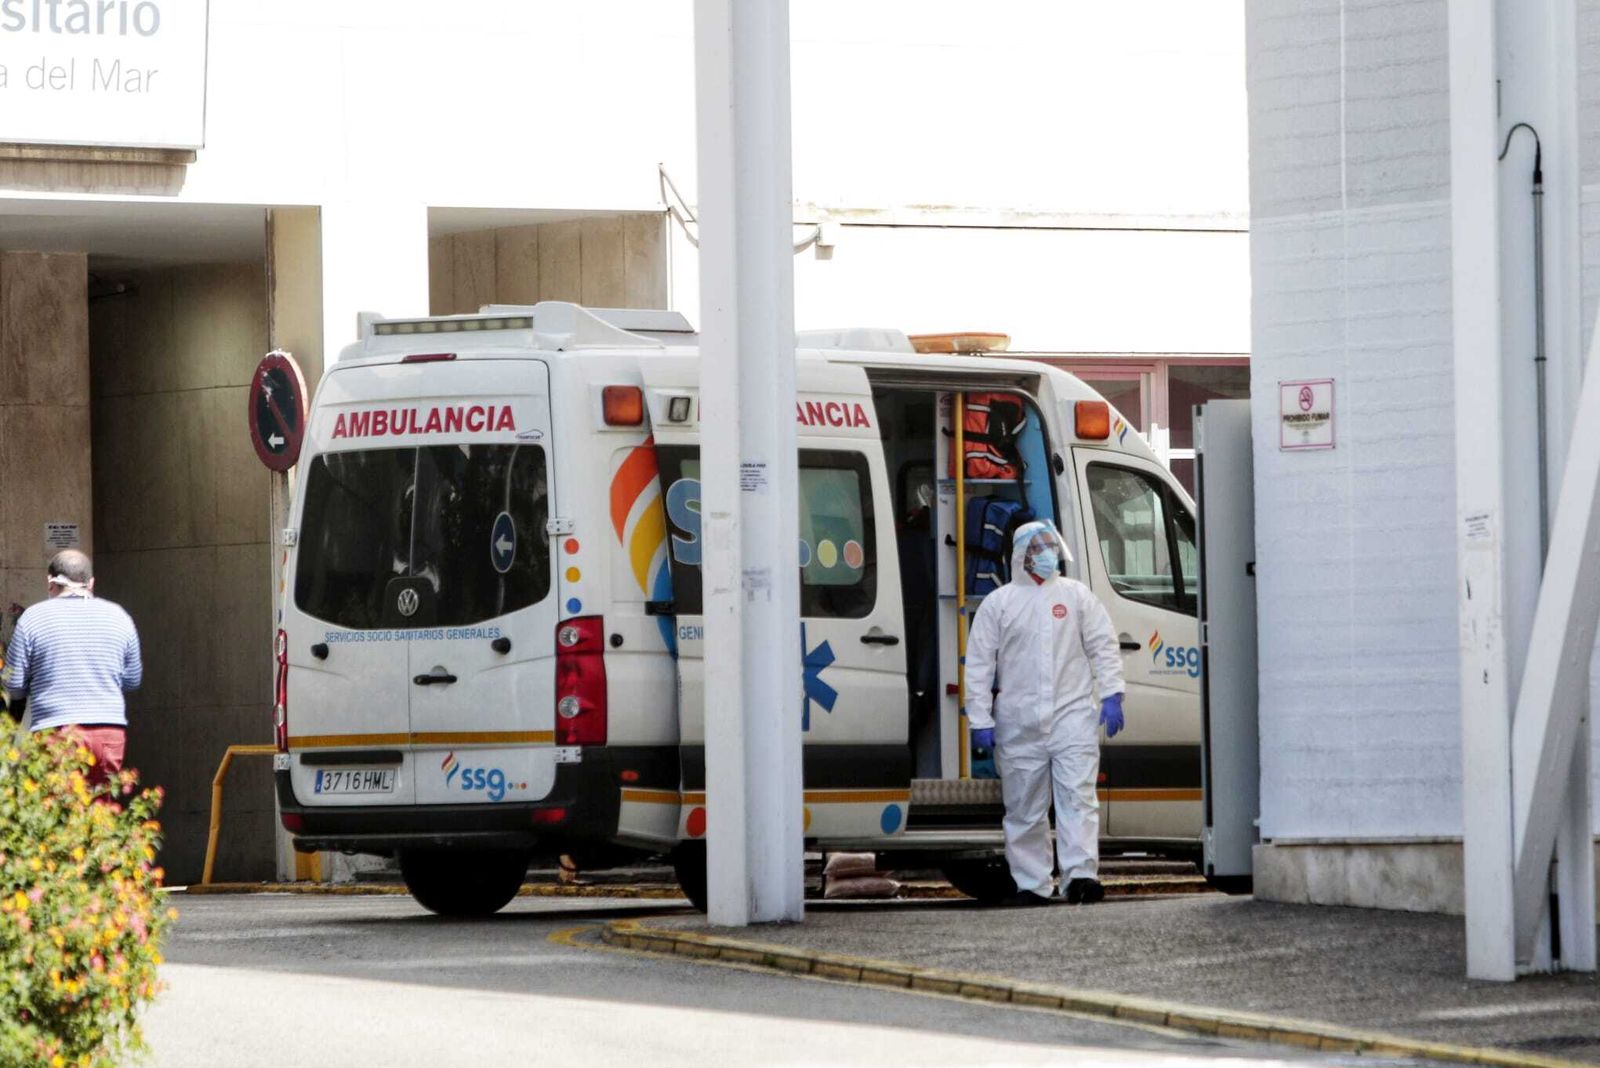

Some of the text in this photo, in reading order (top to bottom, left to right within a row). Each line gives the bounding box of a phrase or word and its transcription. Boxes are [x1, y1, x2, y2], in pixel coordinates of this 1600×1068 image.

[0, 0, 161, 37] sitario
[26, 56, 75, 91] del
[92, 57, 159, 94] Mar
[331, 405, 517, 440] AMBULANCIA
[324, 627, 502, 643] SERVICIOS SOCIO SANITARIOS GENERALES
[1165, 646, 1201, 678] ssg
[461, 767, 506, 801] ssg
